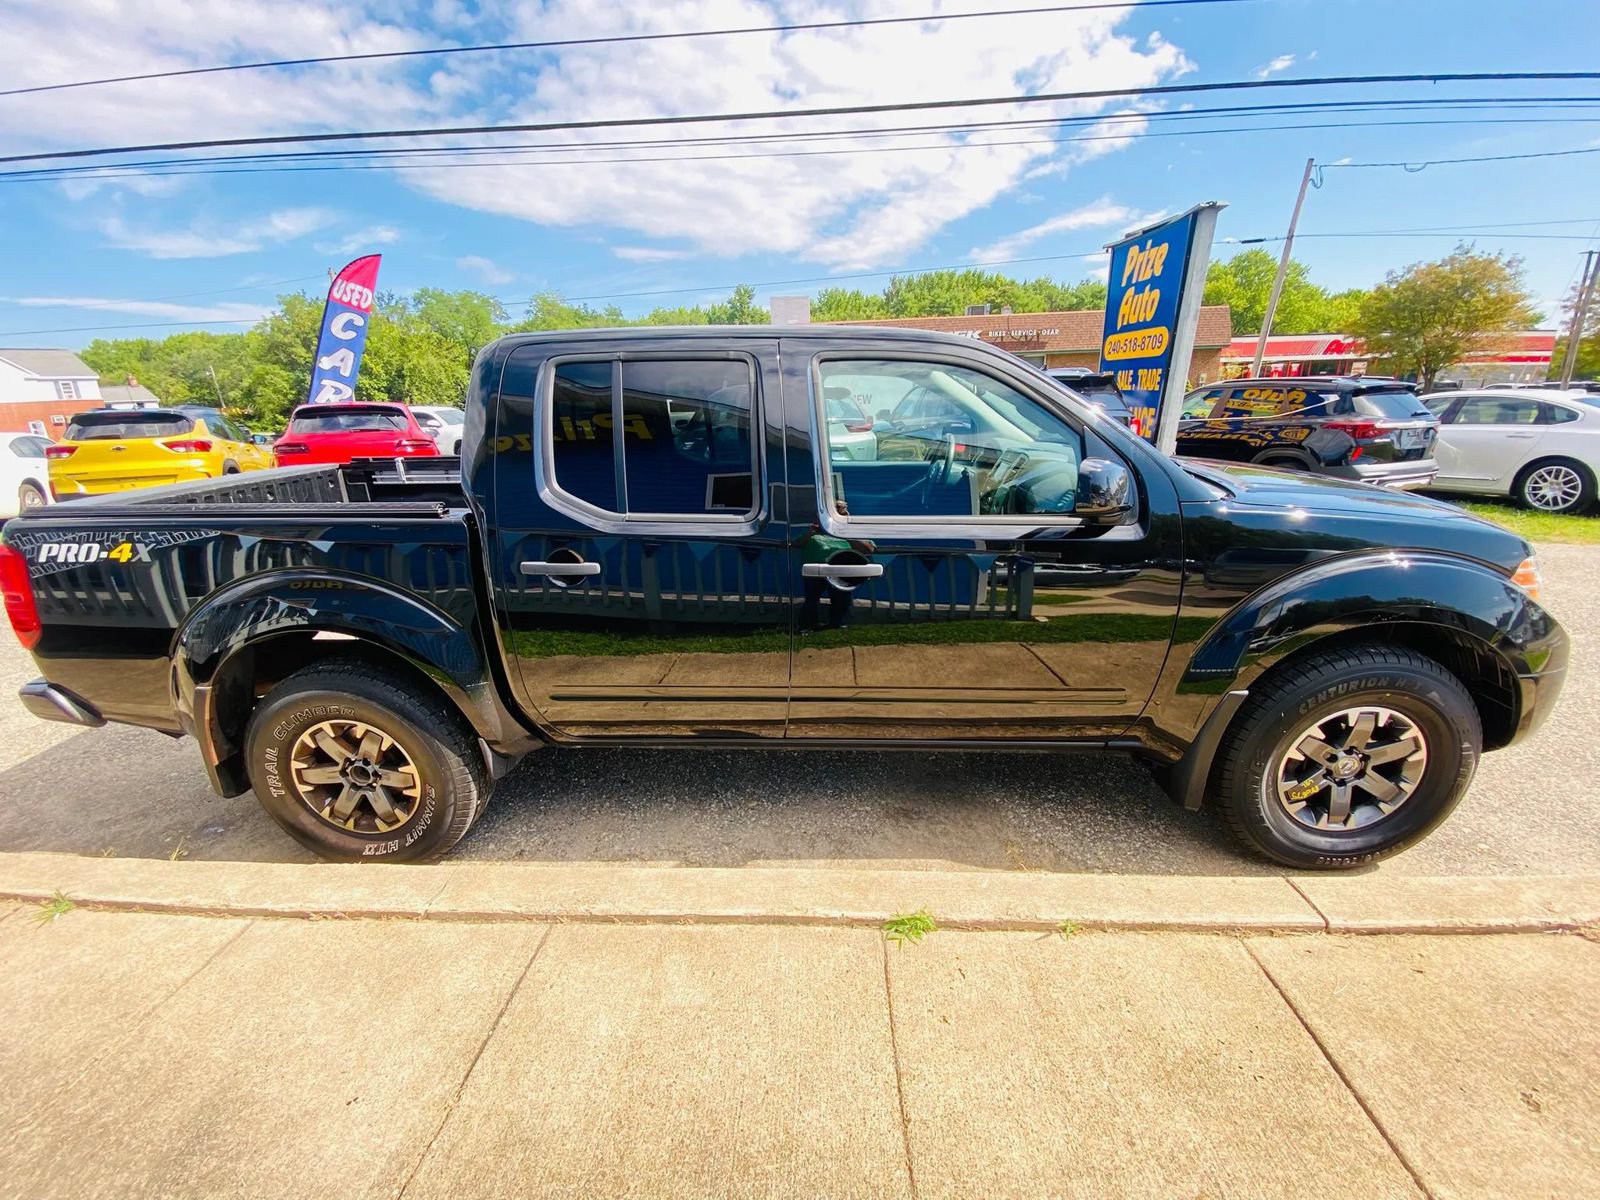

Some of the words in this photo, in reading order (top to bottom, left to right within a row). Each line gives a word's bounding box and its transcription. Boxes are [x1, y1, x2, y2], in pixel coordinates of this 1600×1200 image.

[1121, 239, 1169, 287] Prize
[332, 279, 373, 309] USED
[1117, 284, 1160, 329] Auto
[1107, 333, 1164, 355] 240-518-8709
[1137, 368, 1162, 391] TRADE
[38, 543, 156, 563] PRO-4X
[1299, 677, 1391, 714] CENTURION
[273, 704, 356, 741] CLIMBER
[264, 746, 286, 798] TRAIL
[404, 783, 437, 847] SUMMIT
